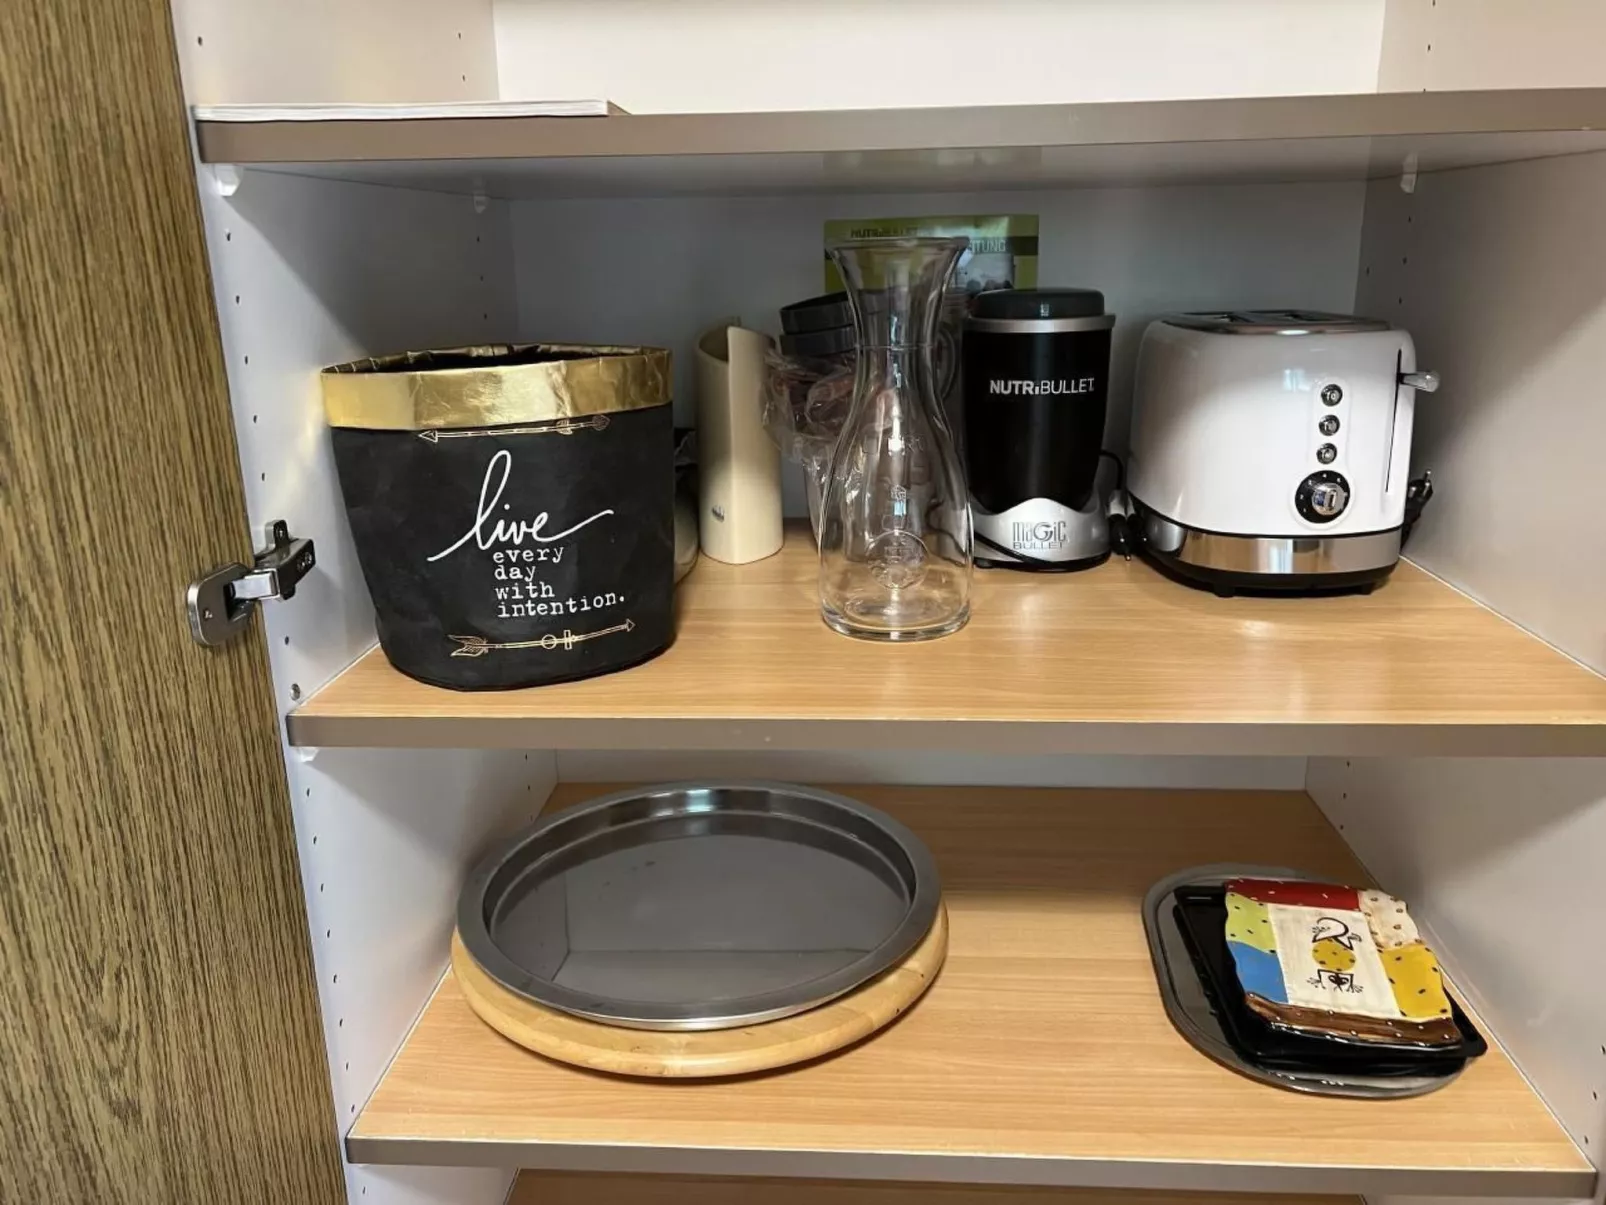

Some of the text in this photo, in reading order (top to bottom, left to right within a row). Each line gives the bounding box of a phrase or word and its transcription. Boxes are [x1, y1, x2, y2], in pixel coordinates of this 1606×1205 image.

[427, 449, 614, 562] live
[492, 546, 564, 563] every
[1012, 541, 1064, 550] BULLET
[494, 565, 536, 582] day
[495, 581, 555, 600] with
[497, 591, 625, 618] intention.
